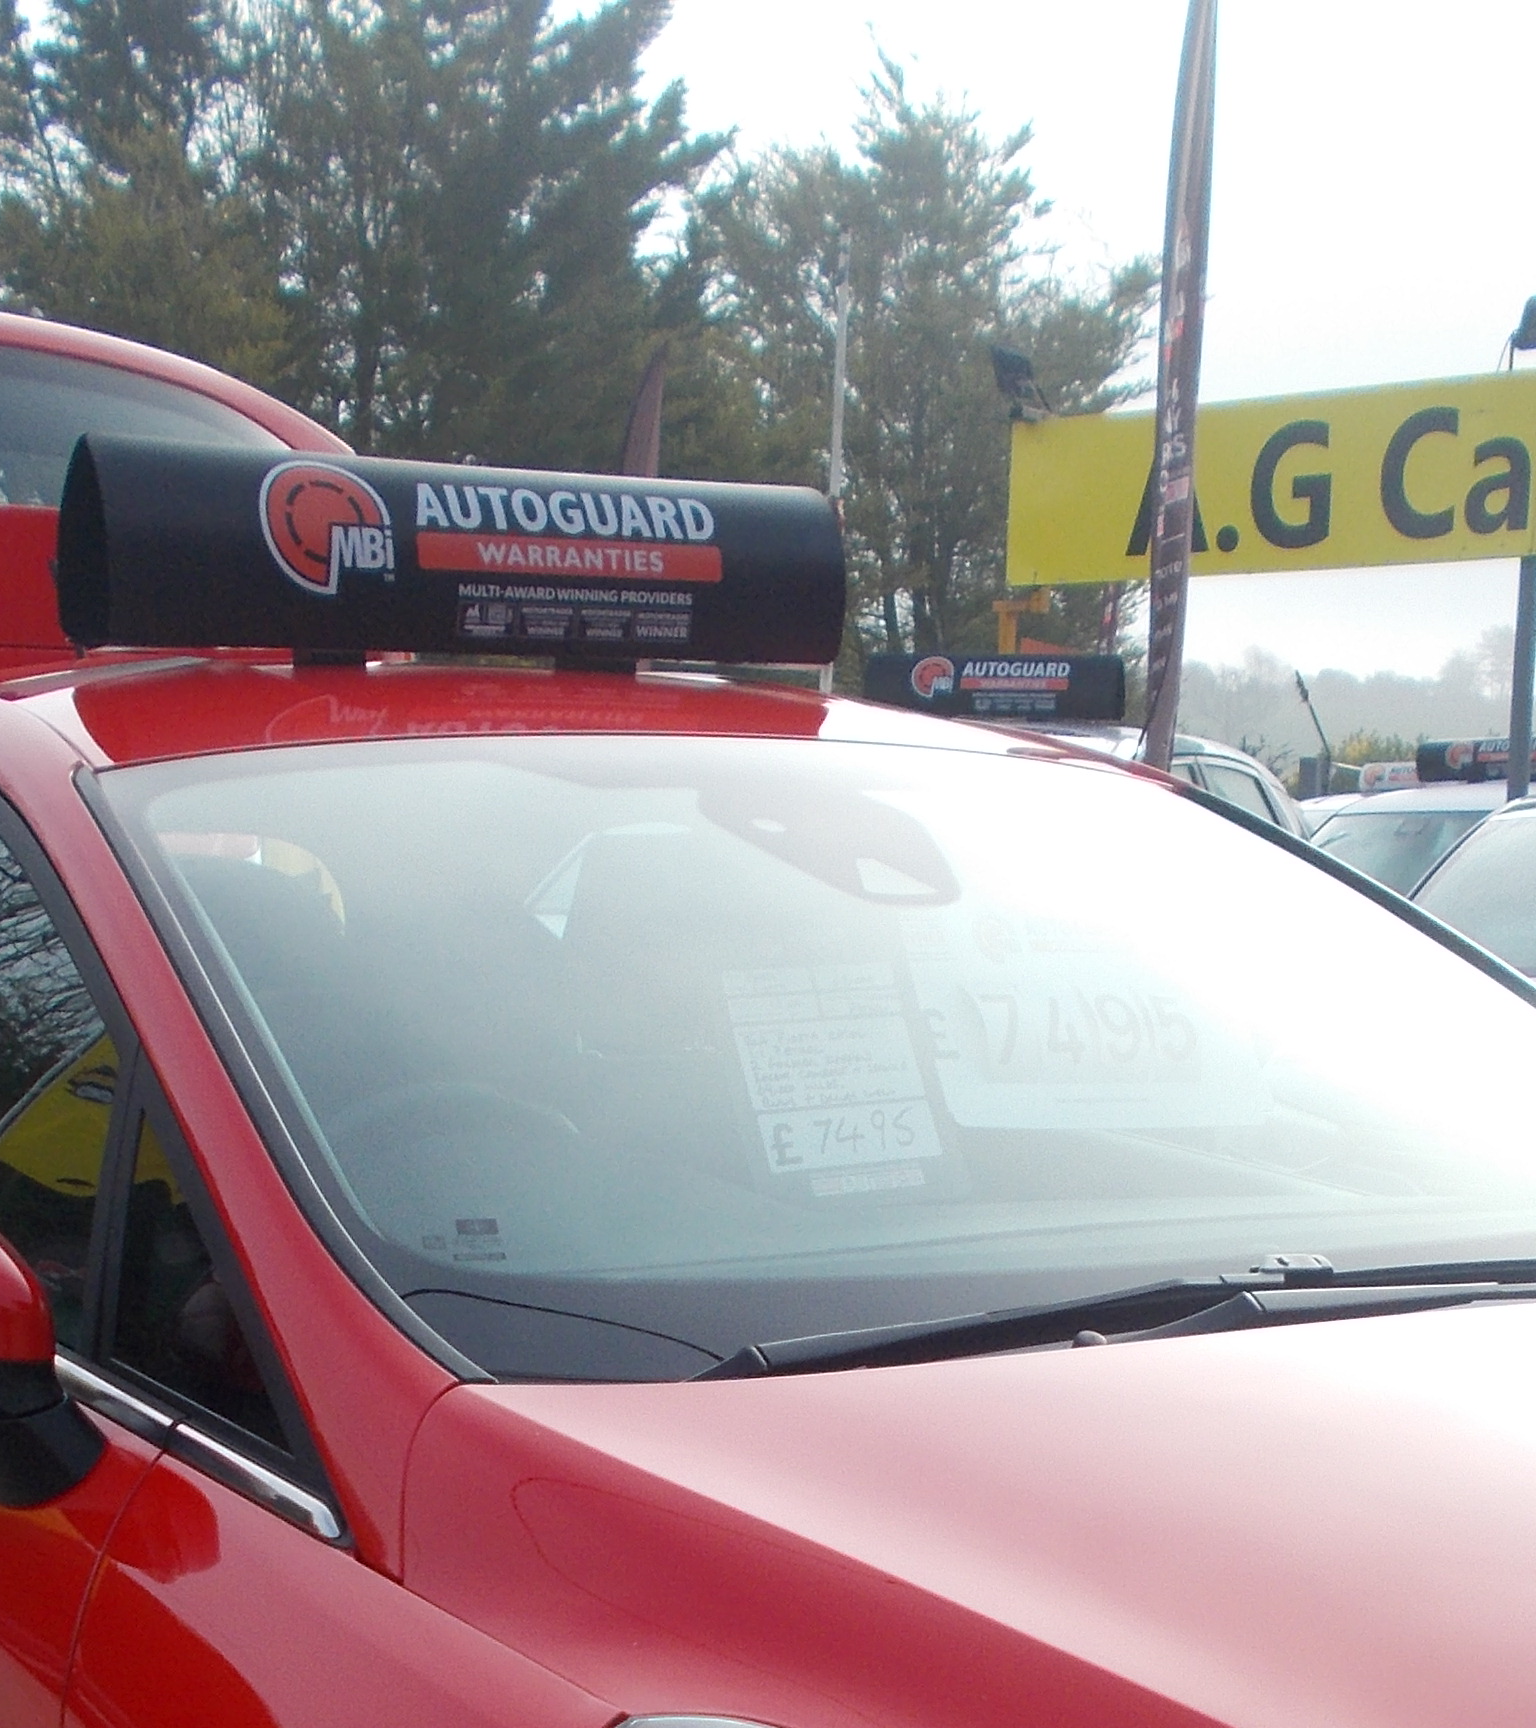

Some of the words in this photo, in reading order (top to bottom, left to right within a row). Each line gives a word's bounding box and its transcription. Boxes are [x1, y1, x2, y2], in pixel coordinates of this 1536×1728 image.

[415, 482, 715, 542] AUTOGUARD
[476, 541, 665, 574] WARRANTIES
[458, 583, 555, 600] MULTI-AWARD
[556, 587, 619, 603] WINNING
[620, 590, 694, 606] PROVIDERS
[636, 625, 688, 639] WINNER
[961, 661, 1071, 678] AUTOGUARD
